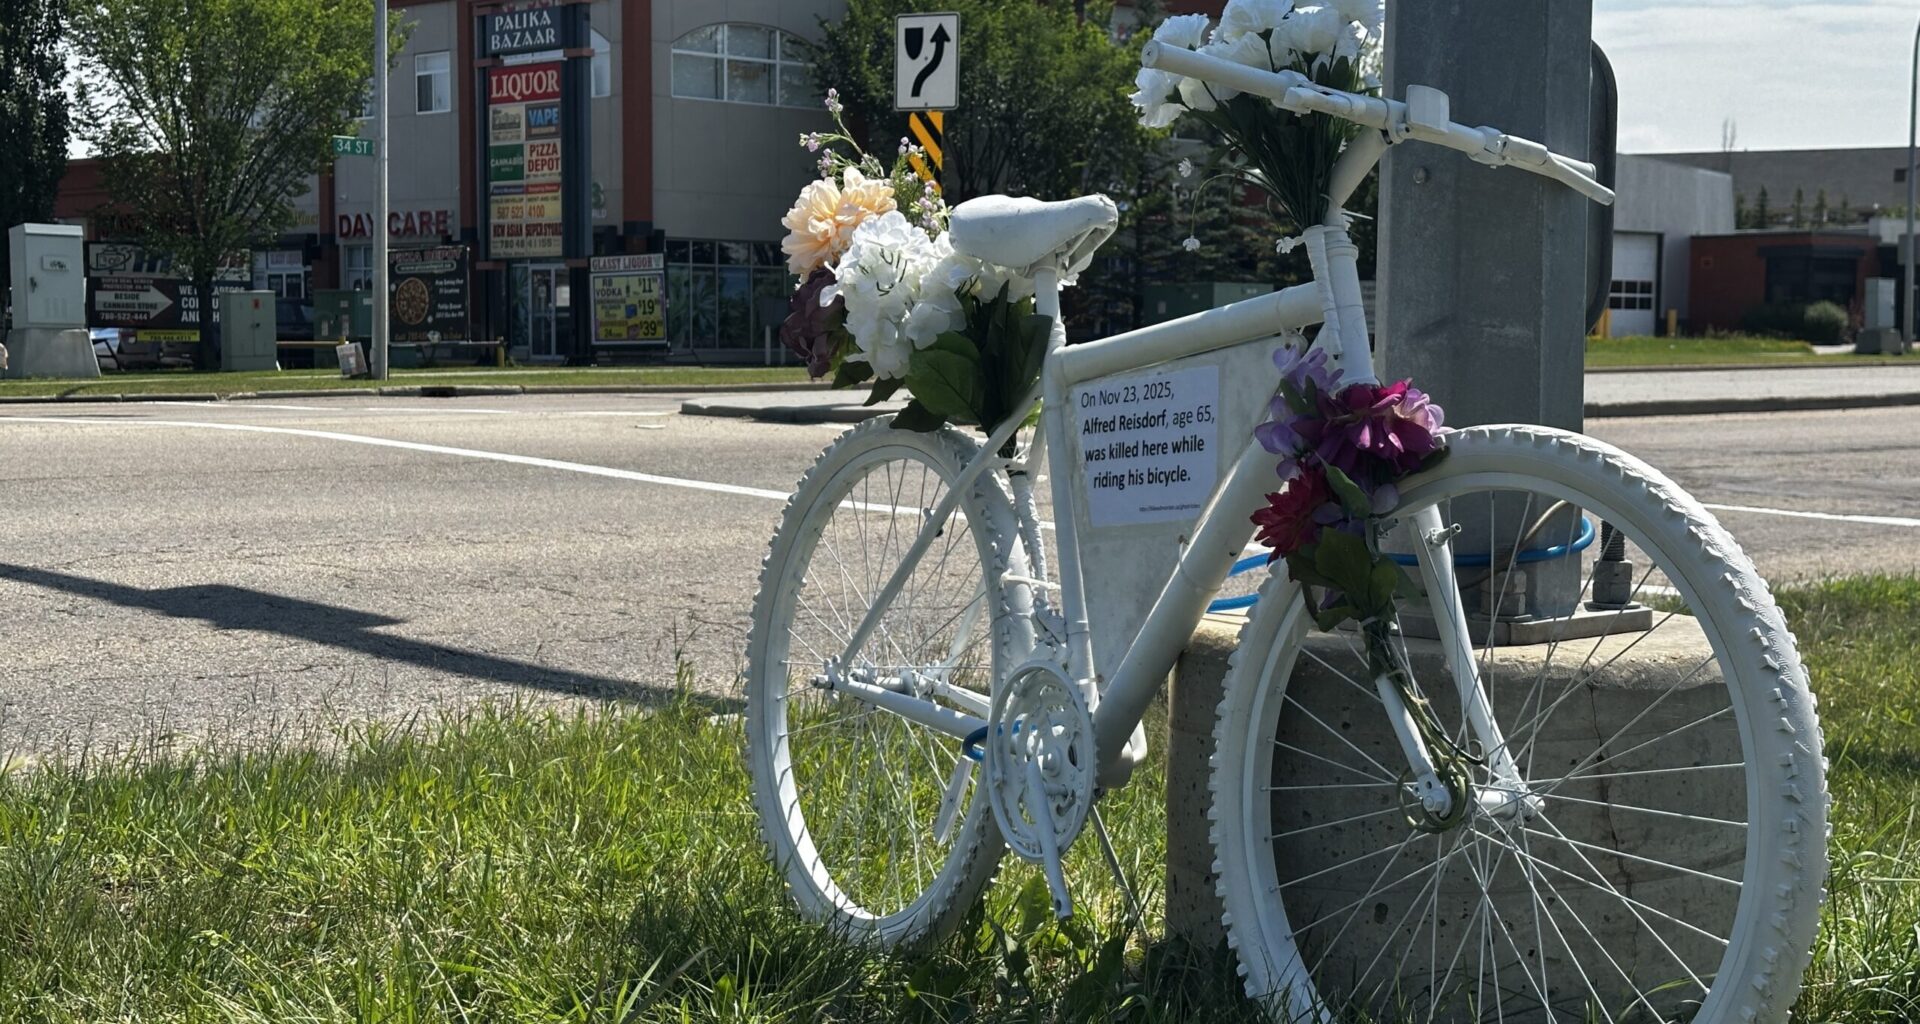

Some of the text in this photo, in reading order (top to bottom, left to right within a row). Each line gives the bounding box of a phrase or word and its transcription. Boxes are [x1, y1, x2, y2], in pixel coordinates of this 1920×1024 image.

[495, 10, 551, 32] PALIKA
[491, 28, 555, 50] BAZAAR
[491, 70, 559, 99] LIQUOR
[528, 108, 559, 126] VAPE
[337, 140, 368, 154] 34 ST
[490, 157, 523, 168] CANNABIS
[528, 157, 560, 172] DEPOT
[528, 204, 545, 218] 4100
[388, 210, 449, 236] CARE
[507, 223, 523, 237] ASIAN
[623, 255, 653, 269] LIQUOR
[179, 285, 191, 295] WE
[596, 287, 622, 297] VODKA
[138, 301, 158, 310] STORE
[1081, 381, 1175, 408] On Nov 23, 2025,
[1083, 405, 1215, 435] Alfred Reisdorf, age 65,
[1085, 434, 1205, 462] was killed here while
[1093, 465, 1191, 490] riding his bicycle.
